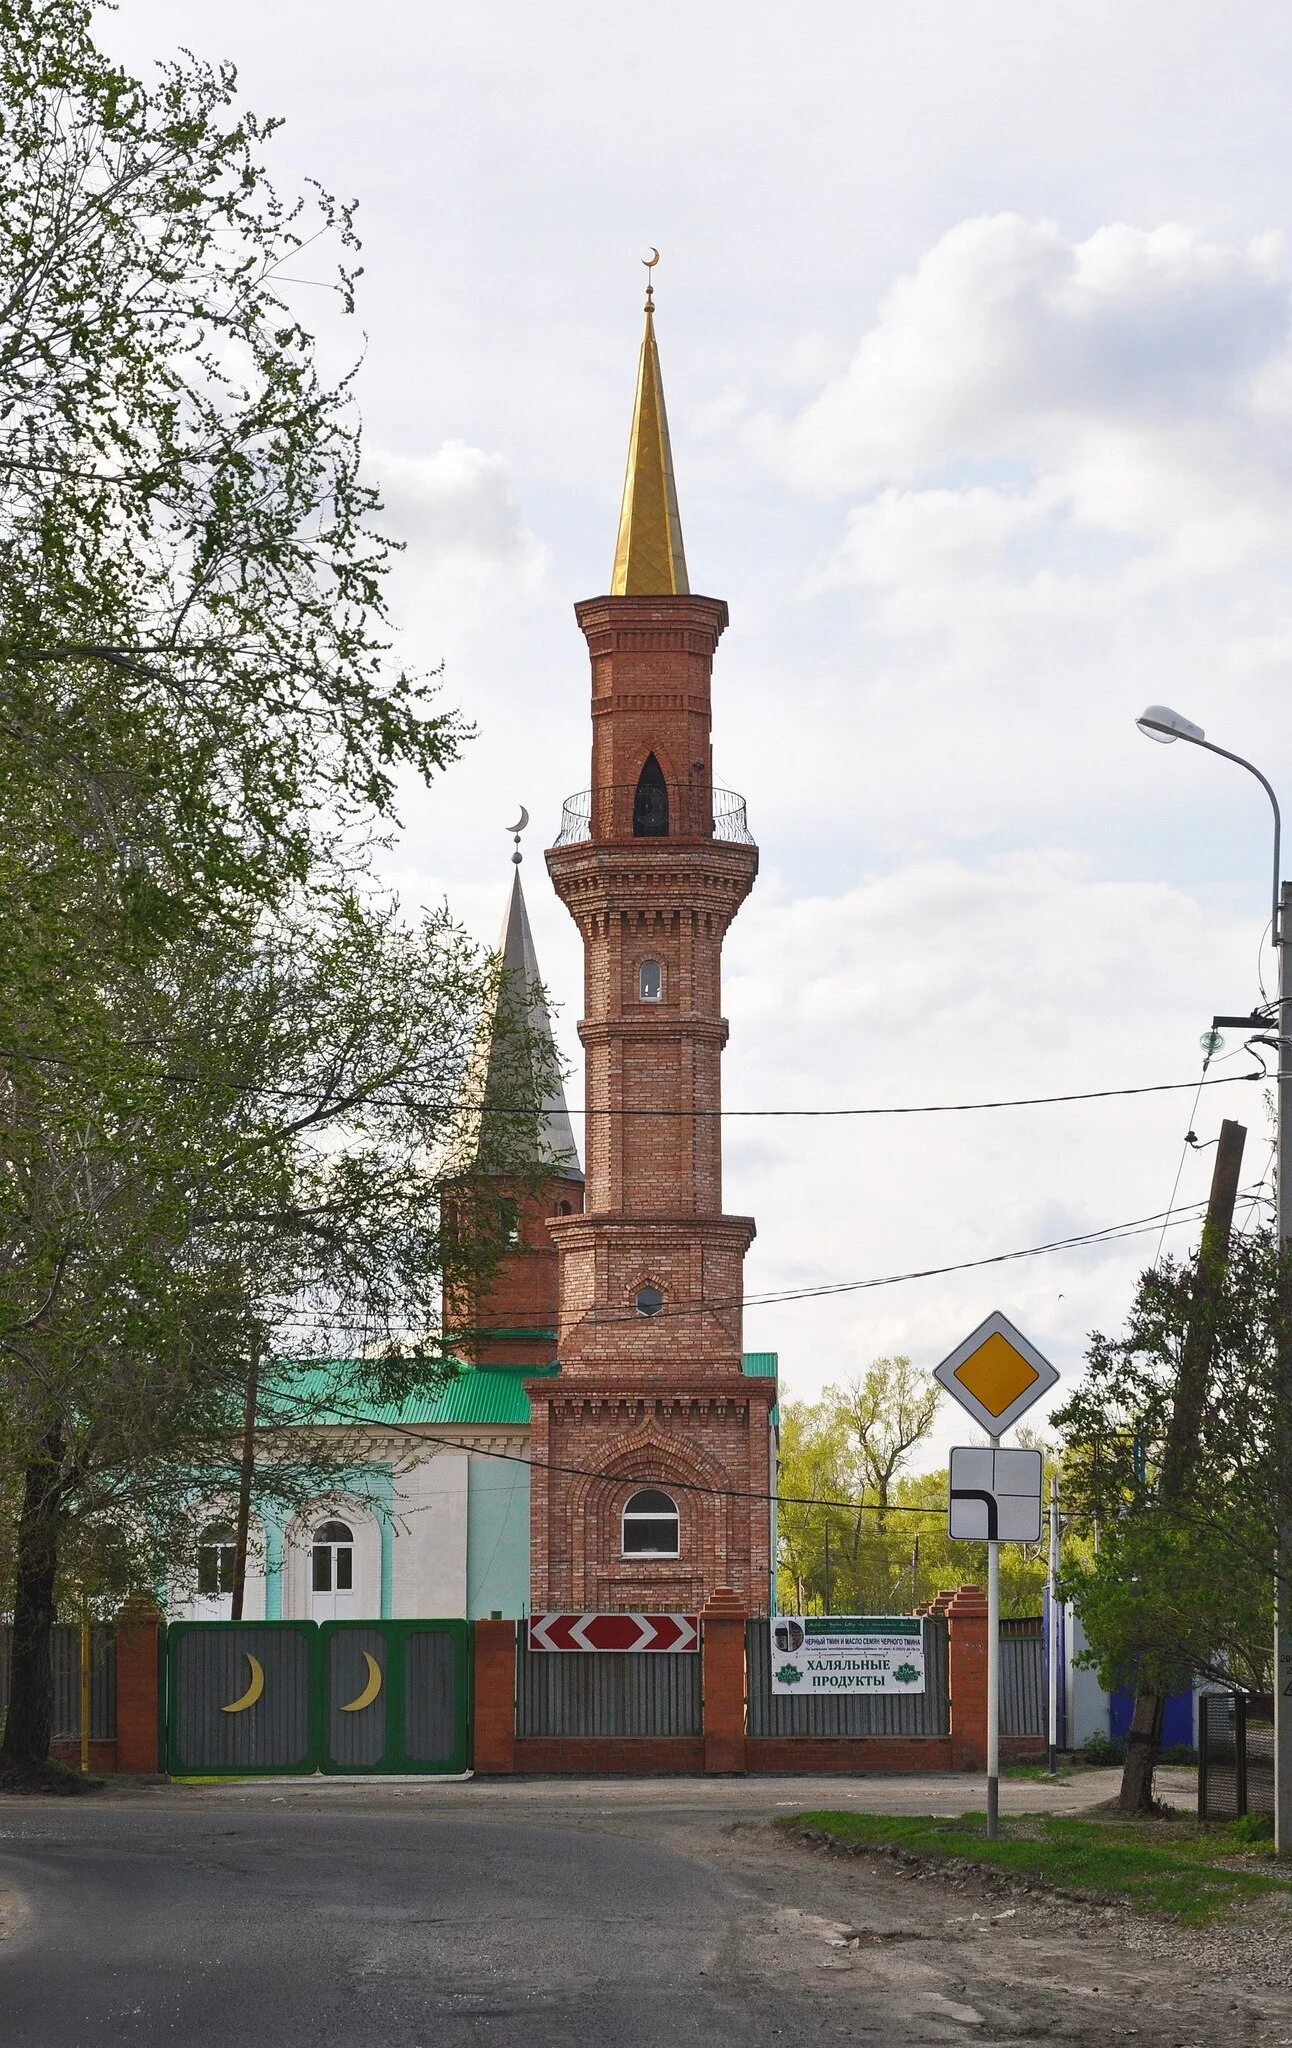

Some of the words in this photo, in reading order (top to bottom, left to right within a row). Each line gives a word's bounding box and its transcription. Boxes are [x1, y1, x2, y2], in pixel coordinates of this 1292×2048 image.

[805, 1637, 825, 1646] ЧЕРНЫЙ
[826, 1637, 839, 1645] ТМИН
[845, 1637, 862, 1645] МАСЛО
[863, 1637, 880, 1645] СЕМЯН
[881, 1638, 903, 1646] ЧЕРНОГО
[904, 1638, 920, 1646] ТМИНА
[807, 1660, 891, 1671] ХАЛЯЛЬНЫЕ
[812, 1676, 885, 1688] ПРОДУКТЫ
